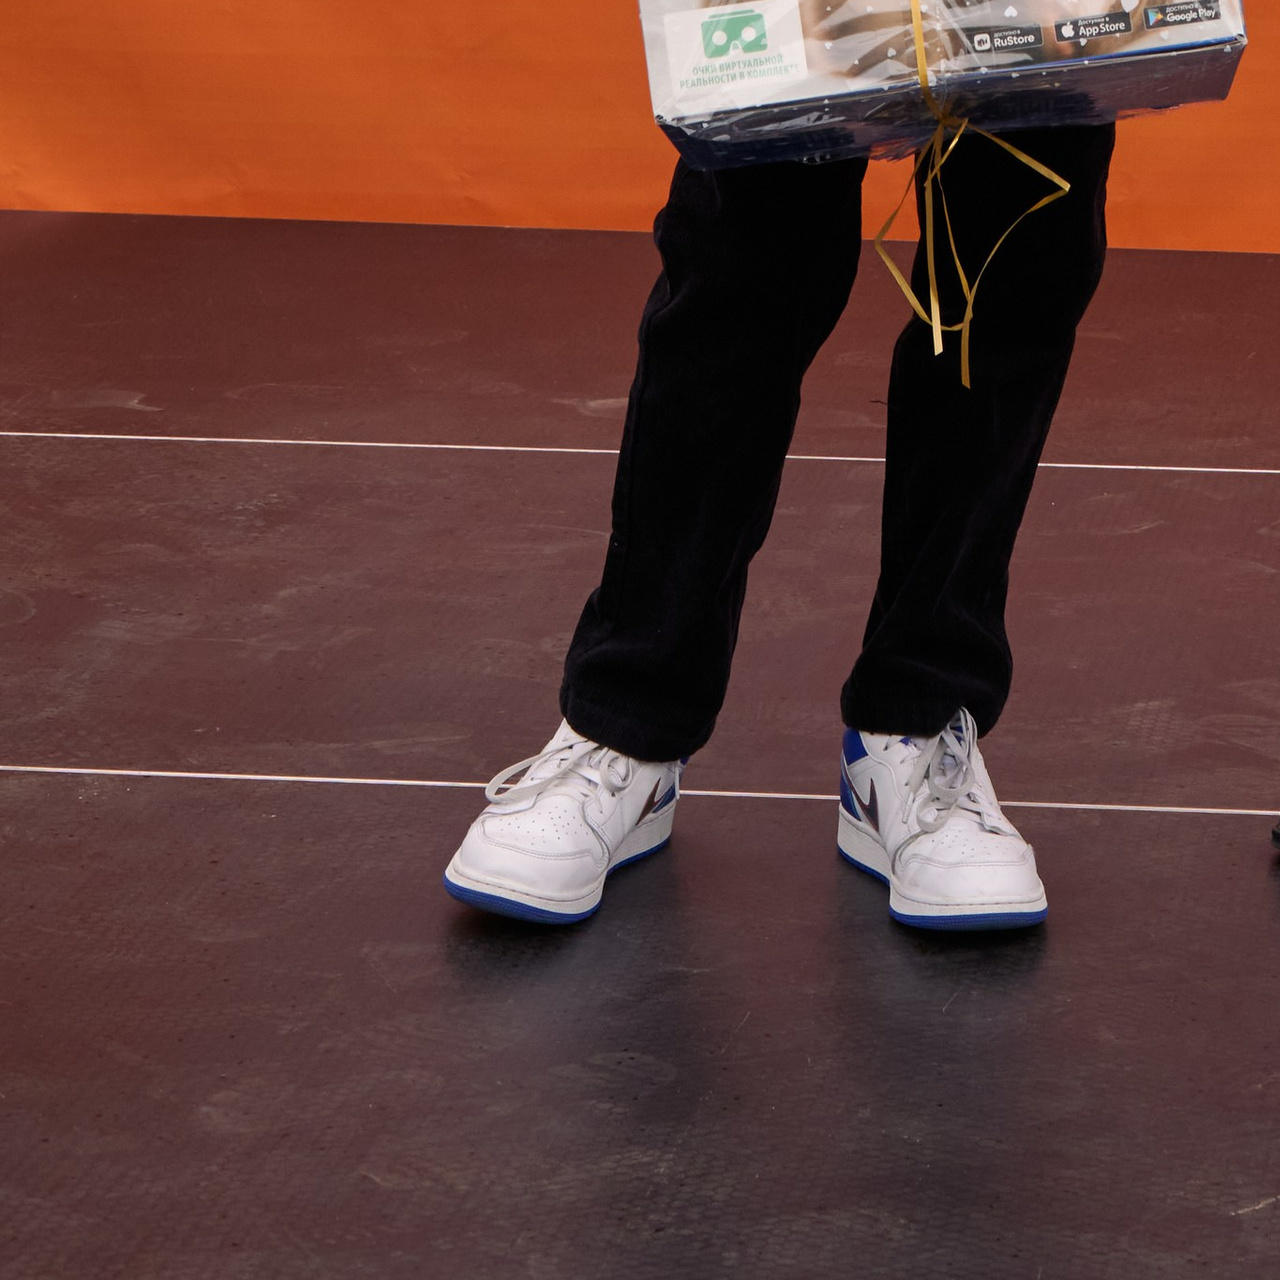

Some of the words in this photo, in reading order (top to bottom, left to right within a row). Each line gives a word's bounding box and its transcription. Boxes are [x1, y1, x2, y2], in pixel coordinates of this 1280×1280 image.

[1166, 11, 1197, 23] Google
[1198, 8, 1216, 19] Play
[1079, 24, 1100, 38] App
[1101, 21, 1126, 34] Store
[994, 34, 1035, 48] RuStore
[692, 64, 717, 76] ОЧКИ
[719, 54, 784, 73] ВИРТУАЛЬНОЙ
[680, 73, 737, 89] РЕАЛЬНОСТИ
[739, 72, 746, 80] В
